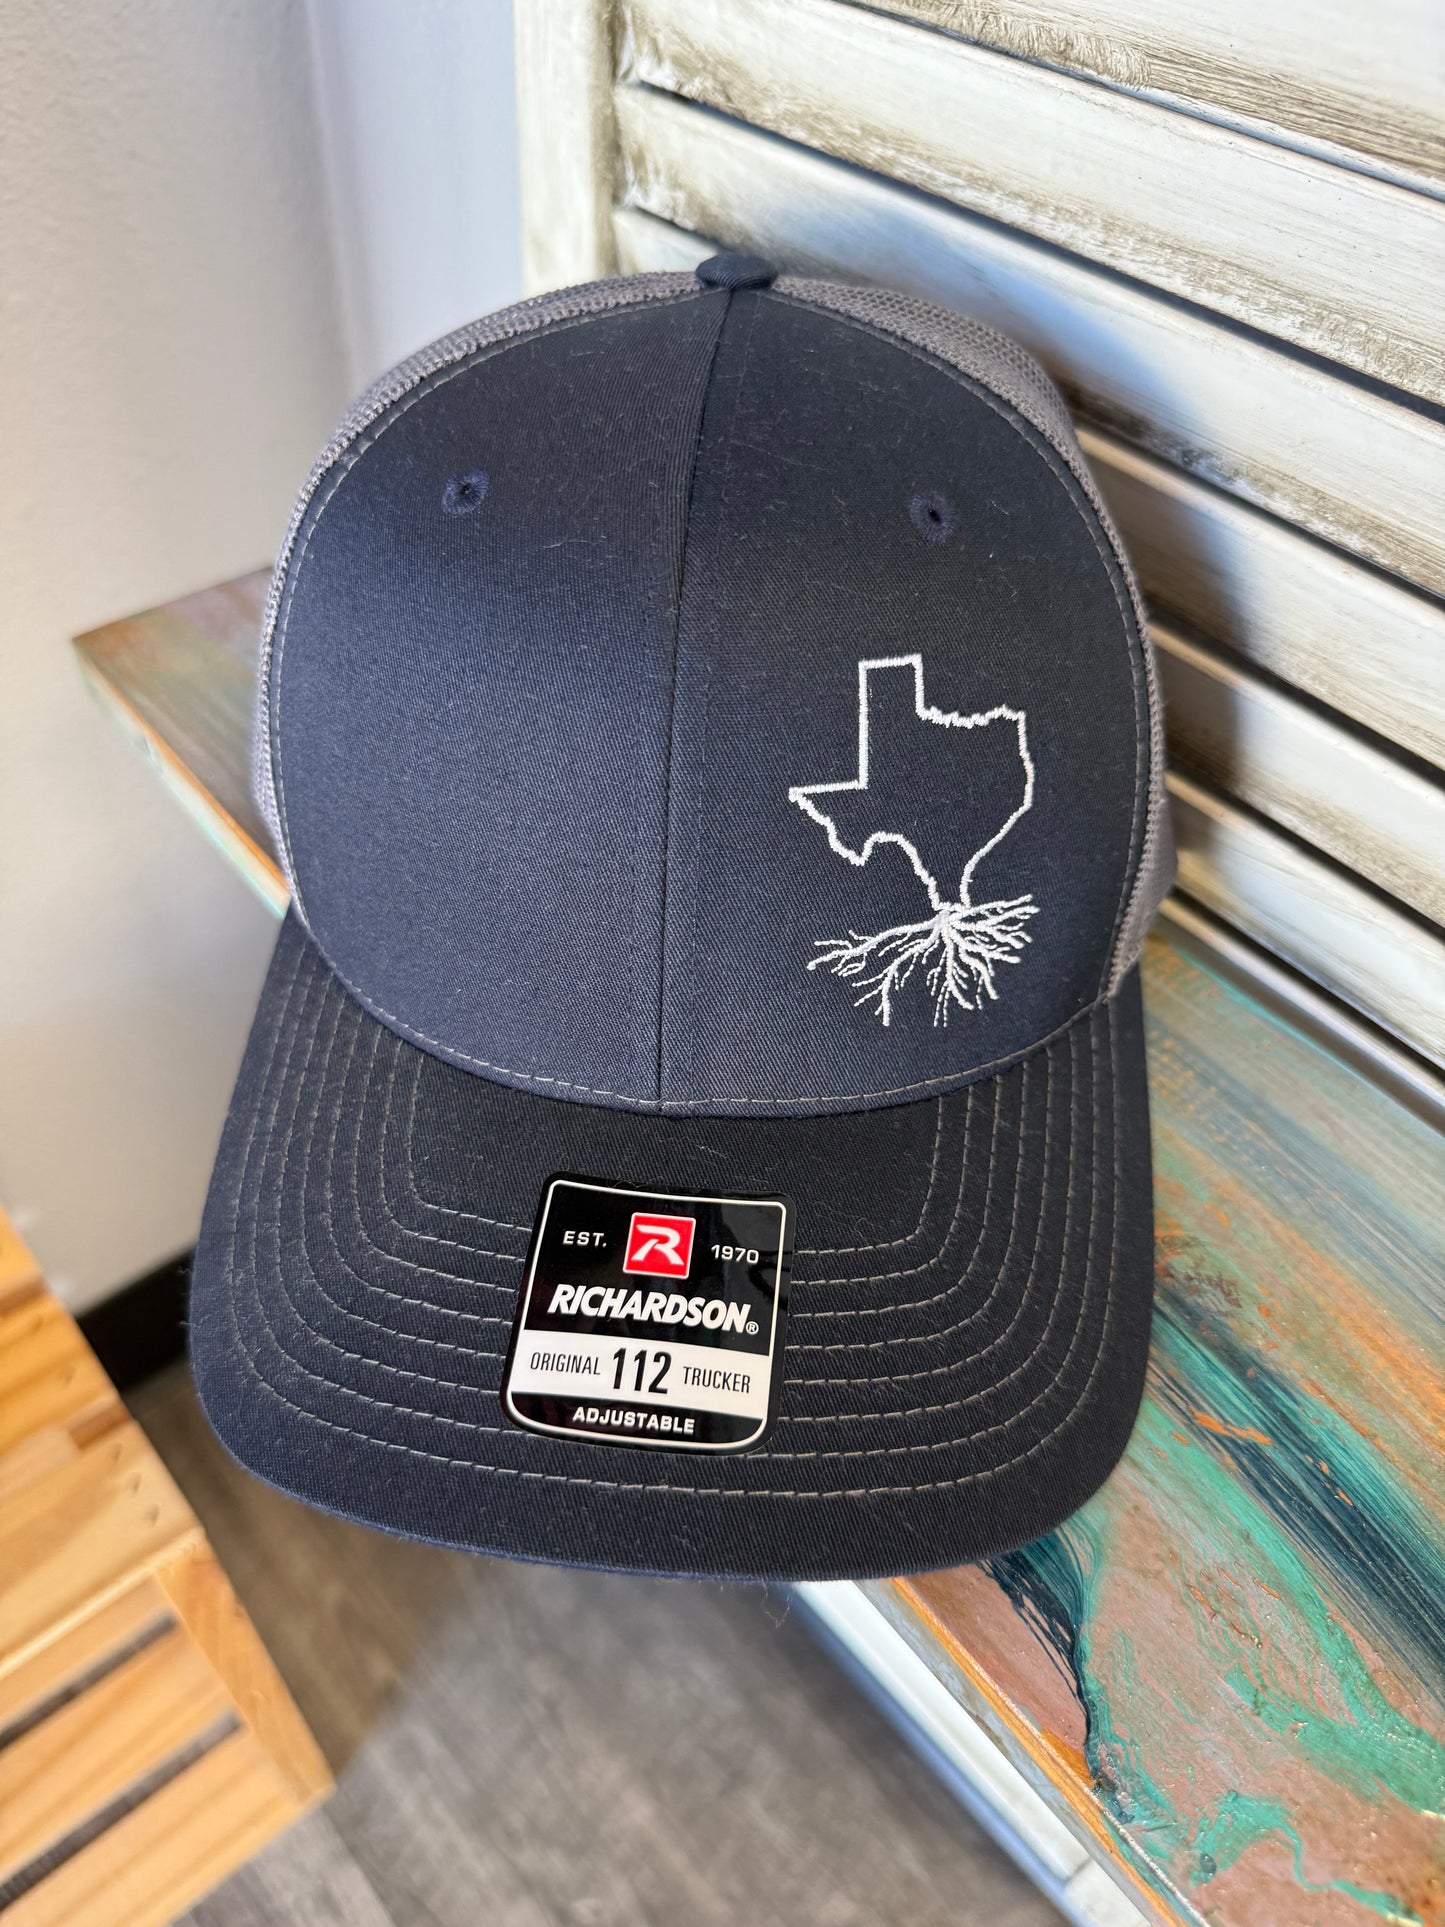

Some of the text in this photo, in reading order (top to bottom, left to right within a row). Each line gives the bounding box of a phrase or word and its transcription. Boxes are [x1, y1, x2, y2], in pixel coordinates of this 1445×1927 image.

[562, 1230, 760, 1264] EST. 1970
[530, 1347, 751, 1395] ORIGINAL 112 TRUCKER
[572, 1406, 695, 1434] ADJUSTABLE
